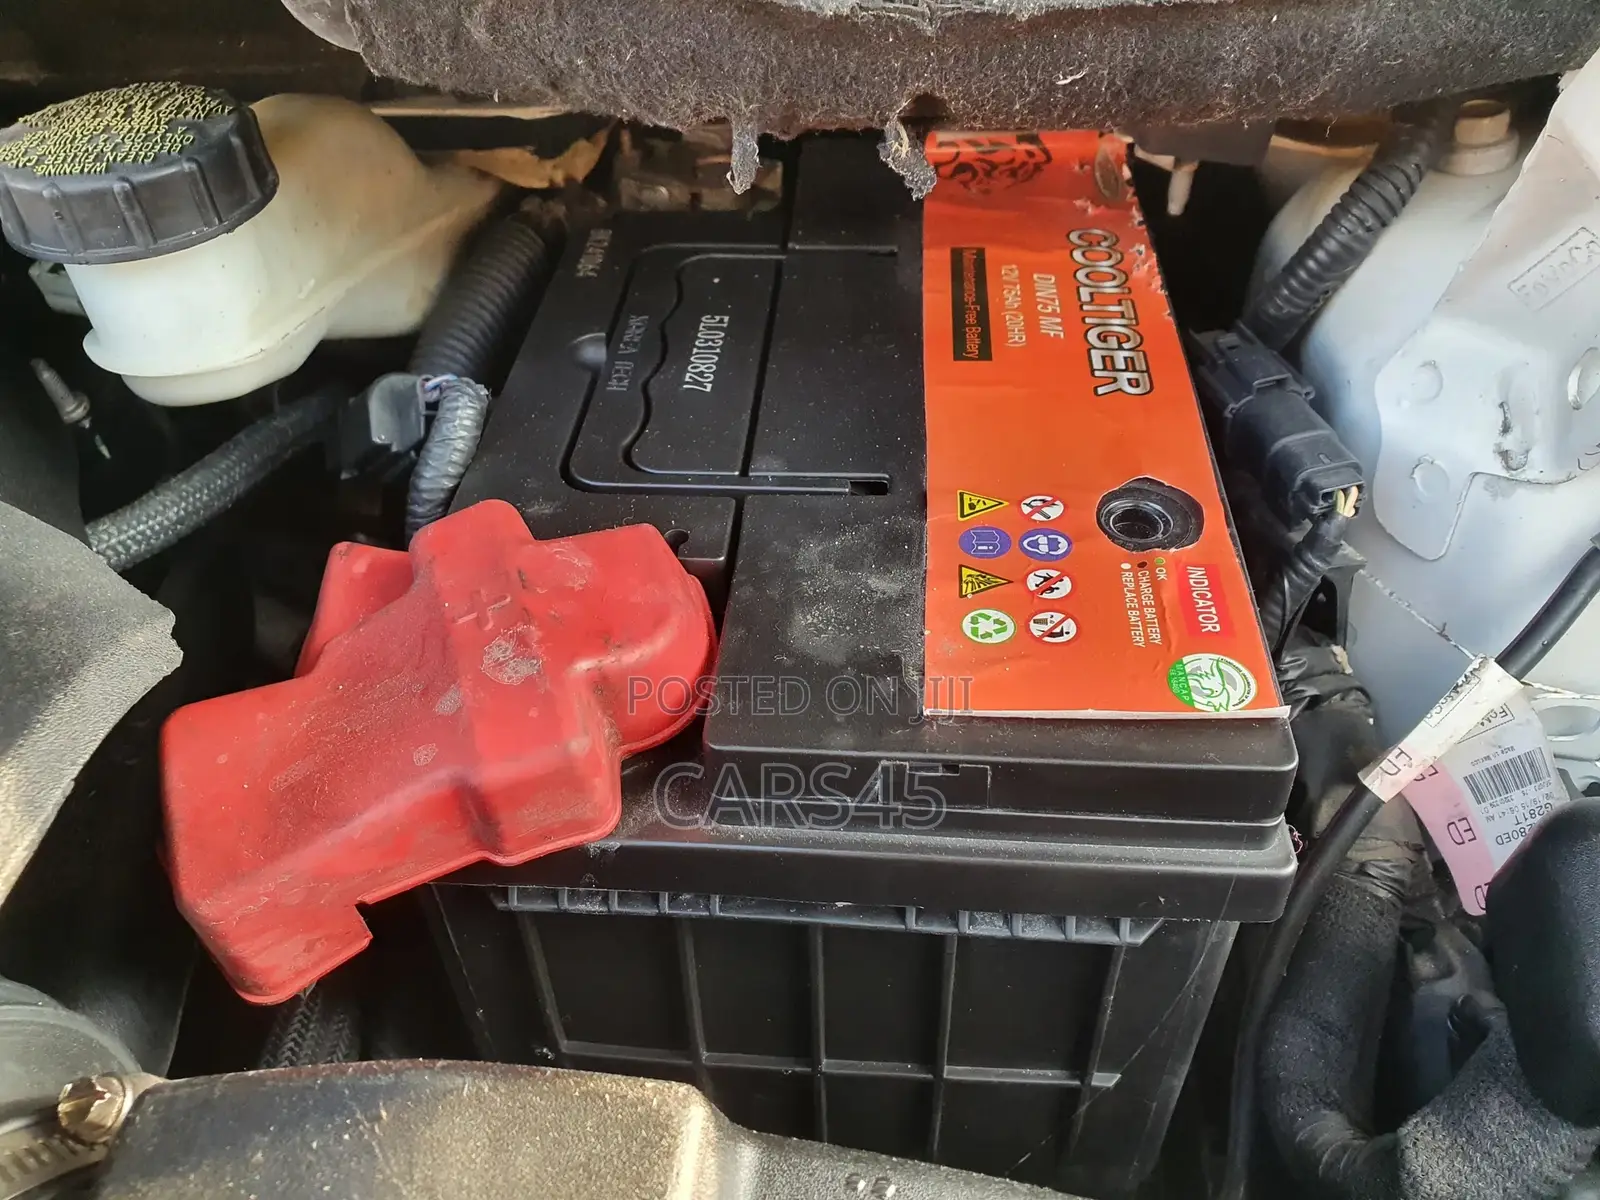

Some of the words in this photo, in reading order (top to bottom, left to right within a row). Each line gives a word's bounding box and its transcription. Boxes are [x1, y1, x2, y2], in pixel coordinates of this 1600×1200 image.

[47, 135, 90, 146] FLUID
[115, 132, 146, 143] DOT
[120, 142, 182, 154] BEFORE
[151, 133, 194, 145] ONLY
[33, 162, 107, 177] WARNING:
[44, 152, 97, 165] FILLER
[102, 151, 155, 163] CLEAN
[1033, 272, 1061, 314] DIN75
[1039, 315, 1064, 339] MF
[1066, 229, 1153, 396] COOLTIGER
[962, 326, 982, 359] Battery
[1001, 311, 1026, 347] (20HR)
[682, 314, 730, 393] 5L0310827
[1137, 570, 1155, 606] CHARGE
[1155, 567, 1168, 581] OK
[1121, 571, 1139, 609] REPLACE
[1186, 566, 1221, 633] INDICATOR
[1127, 610, 1146, 648] BATTERY
[1143, 607, 1162, 645] BATTERY
[1446, 817, 1478, 846] ED
